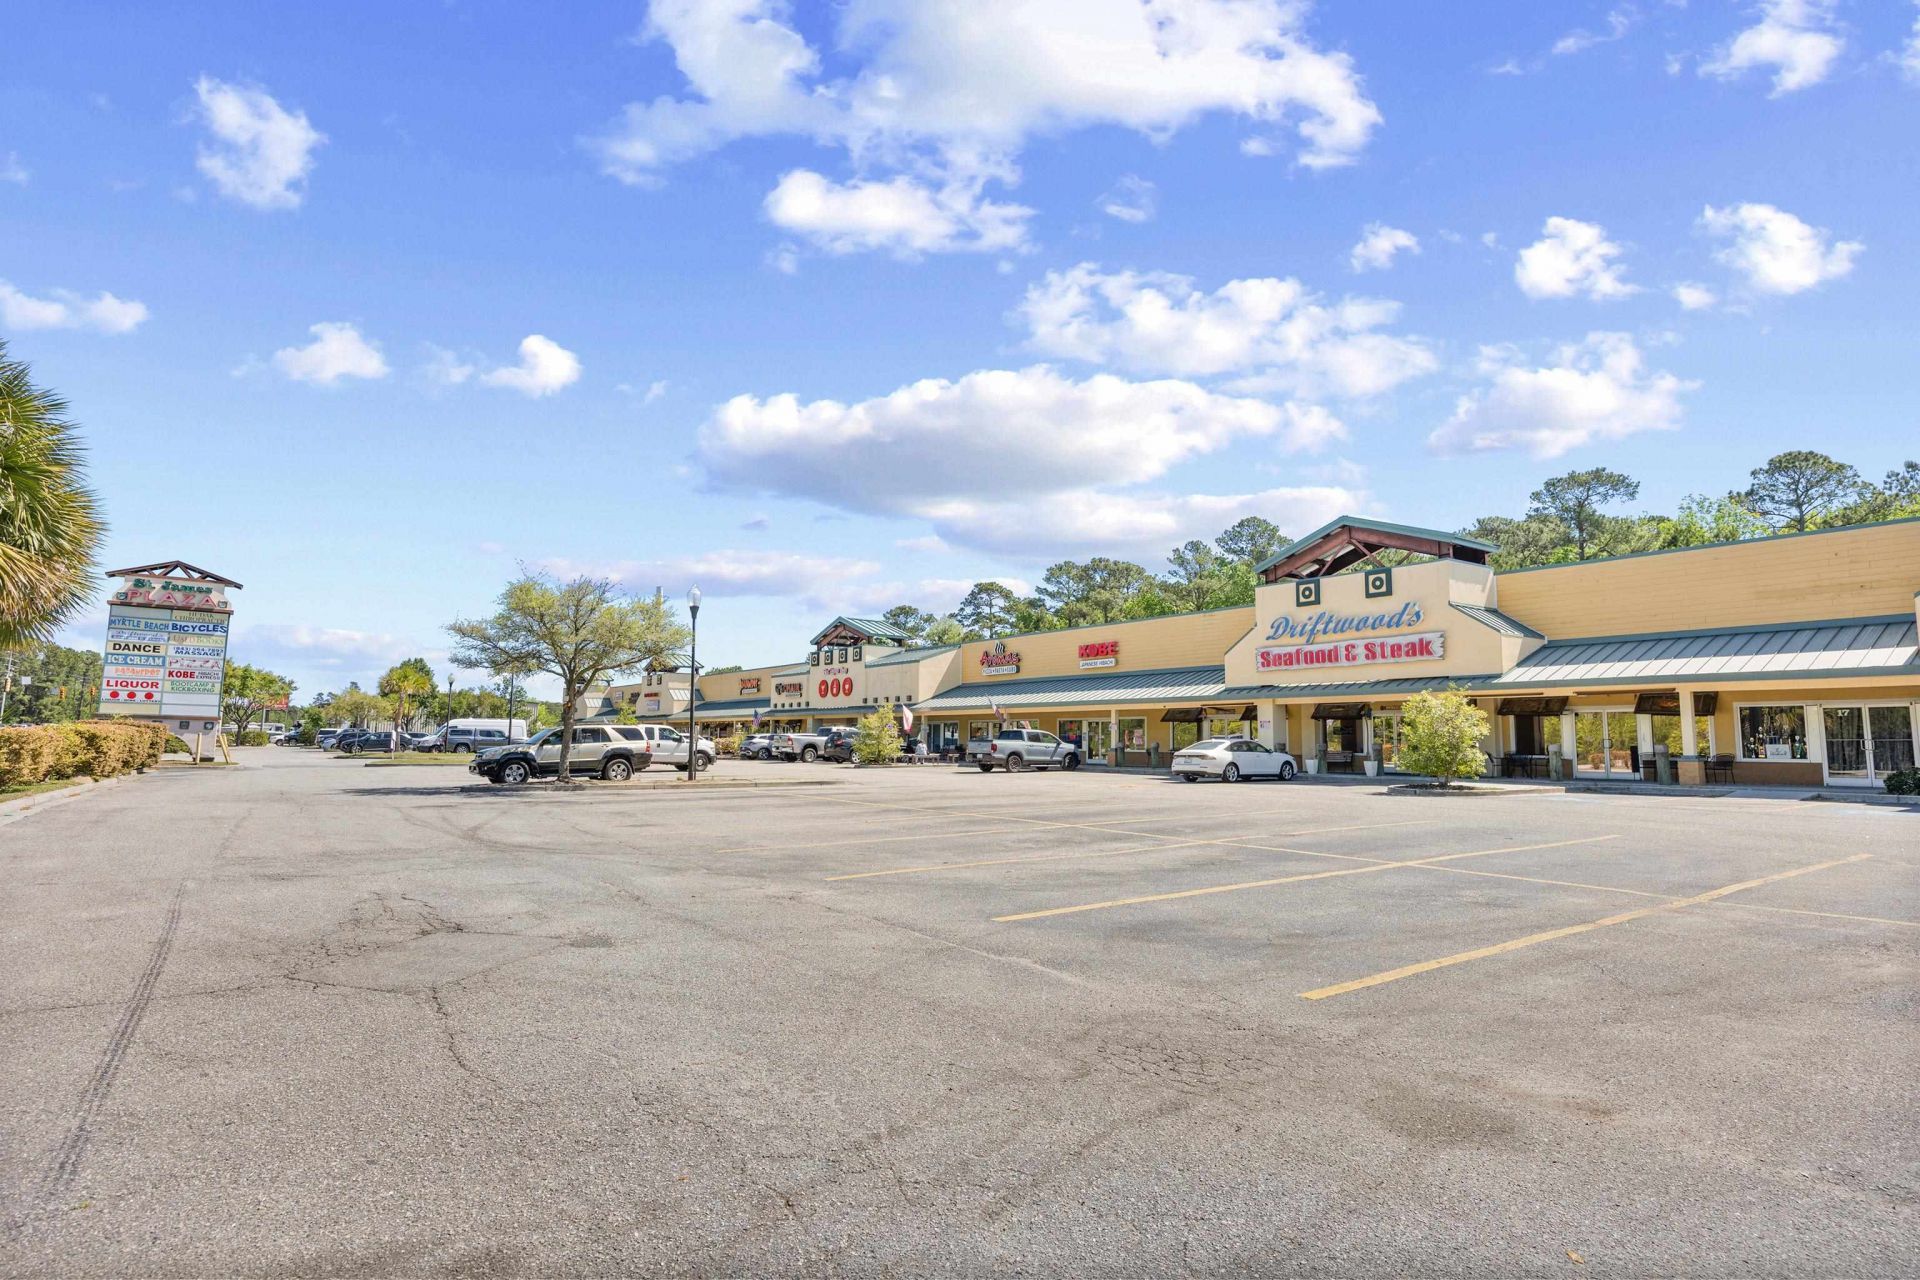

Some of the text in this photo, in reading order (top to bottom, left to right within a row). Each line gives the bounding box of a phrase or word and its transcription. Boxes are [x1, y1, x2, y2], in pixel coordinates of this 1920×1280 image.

[161, 581, 213, 594] James
[127, 590, 218, 609] PLAZA
[109, 617, 170, 631] MYRTLE BEACH
[171, 622, 227, 634] BICYCLES
[1265, 601, 1425, 645] Driftwood's
[112, 642, 161, 654] DANCE
[1078, 640, 1119, 658] KOBE
[1260, 645, 1339, 668] Seafood
[1364, 637, 1434, 661] Steak
[107, 654, 163, 666] ICE CREAM
[168, 670, 196, 679] KOBE
[106, 679, 160, 689] LIQUOR
[170, 680, 210, 688] BOOTCAMP
[1837, 709, 1850, 717] 17
